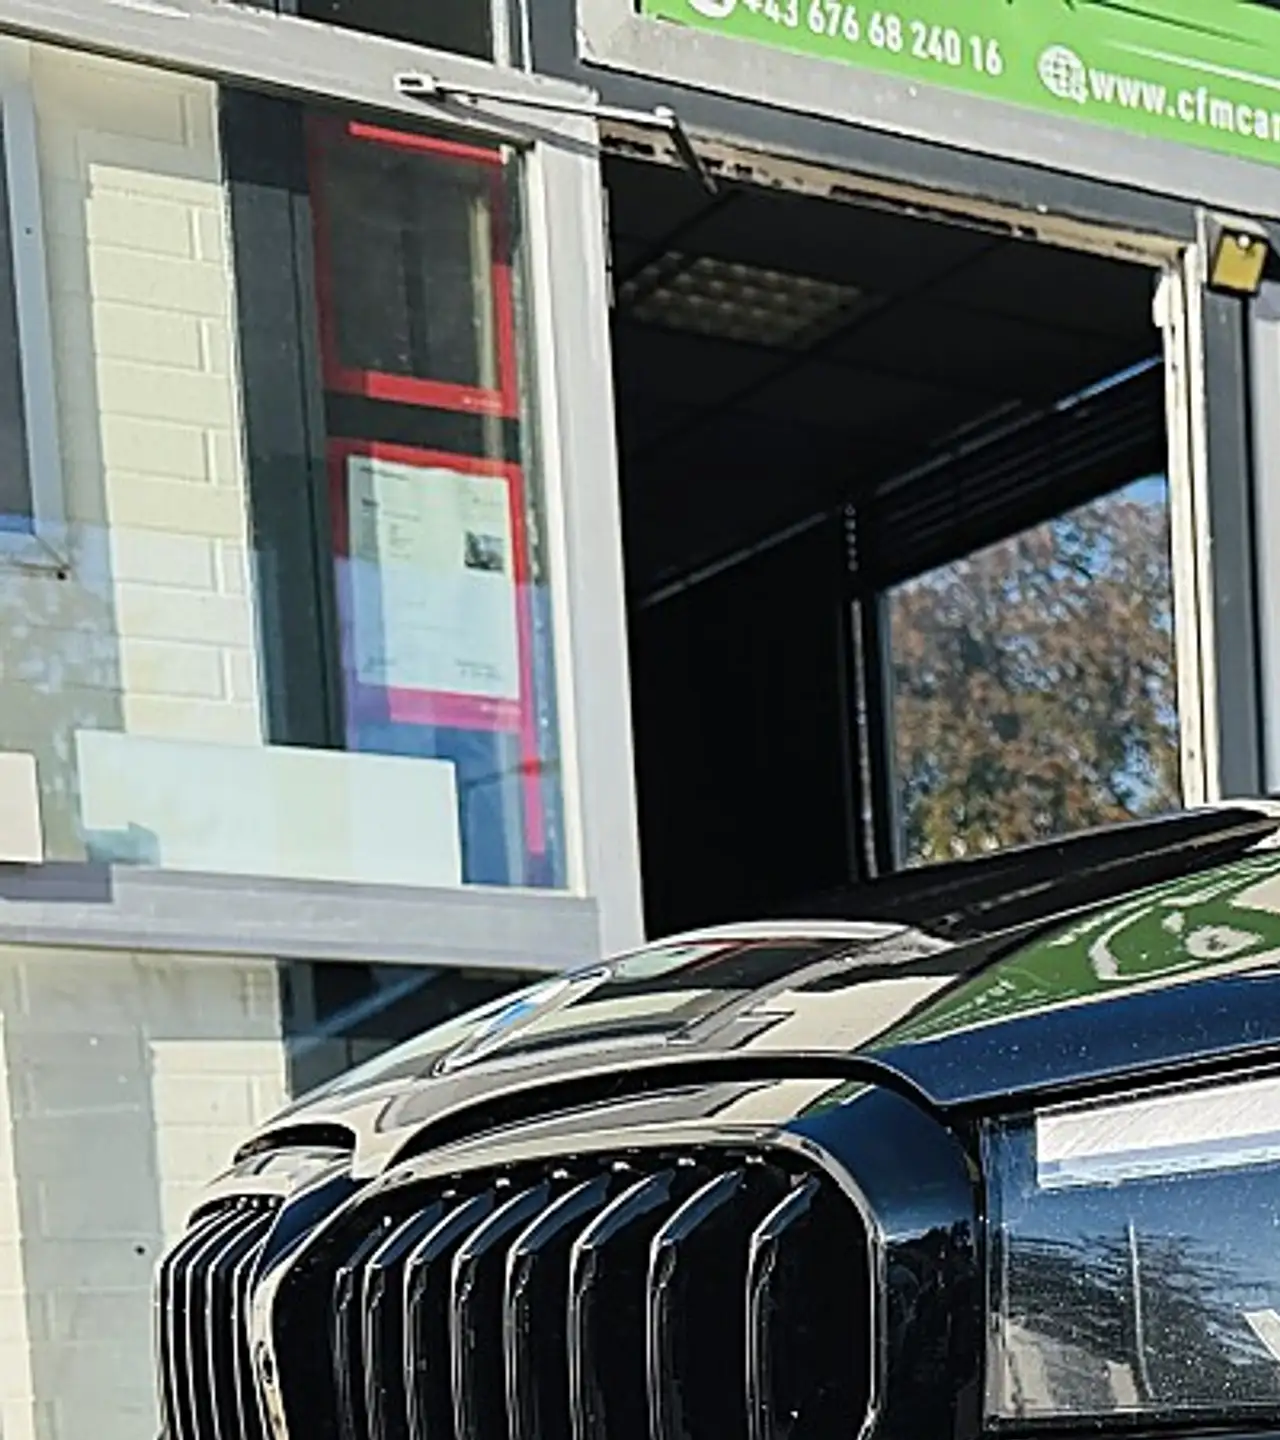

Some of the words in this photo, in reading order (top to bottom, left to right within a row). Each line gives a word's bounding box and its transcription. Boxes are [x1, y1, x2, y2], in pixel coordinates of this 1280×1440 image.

[808, 2, 859, 42] 676
[868, 10, 904, 52] 68
[909, 19, 962, 66] 240
[969, 34, 1004, 76] 16
